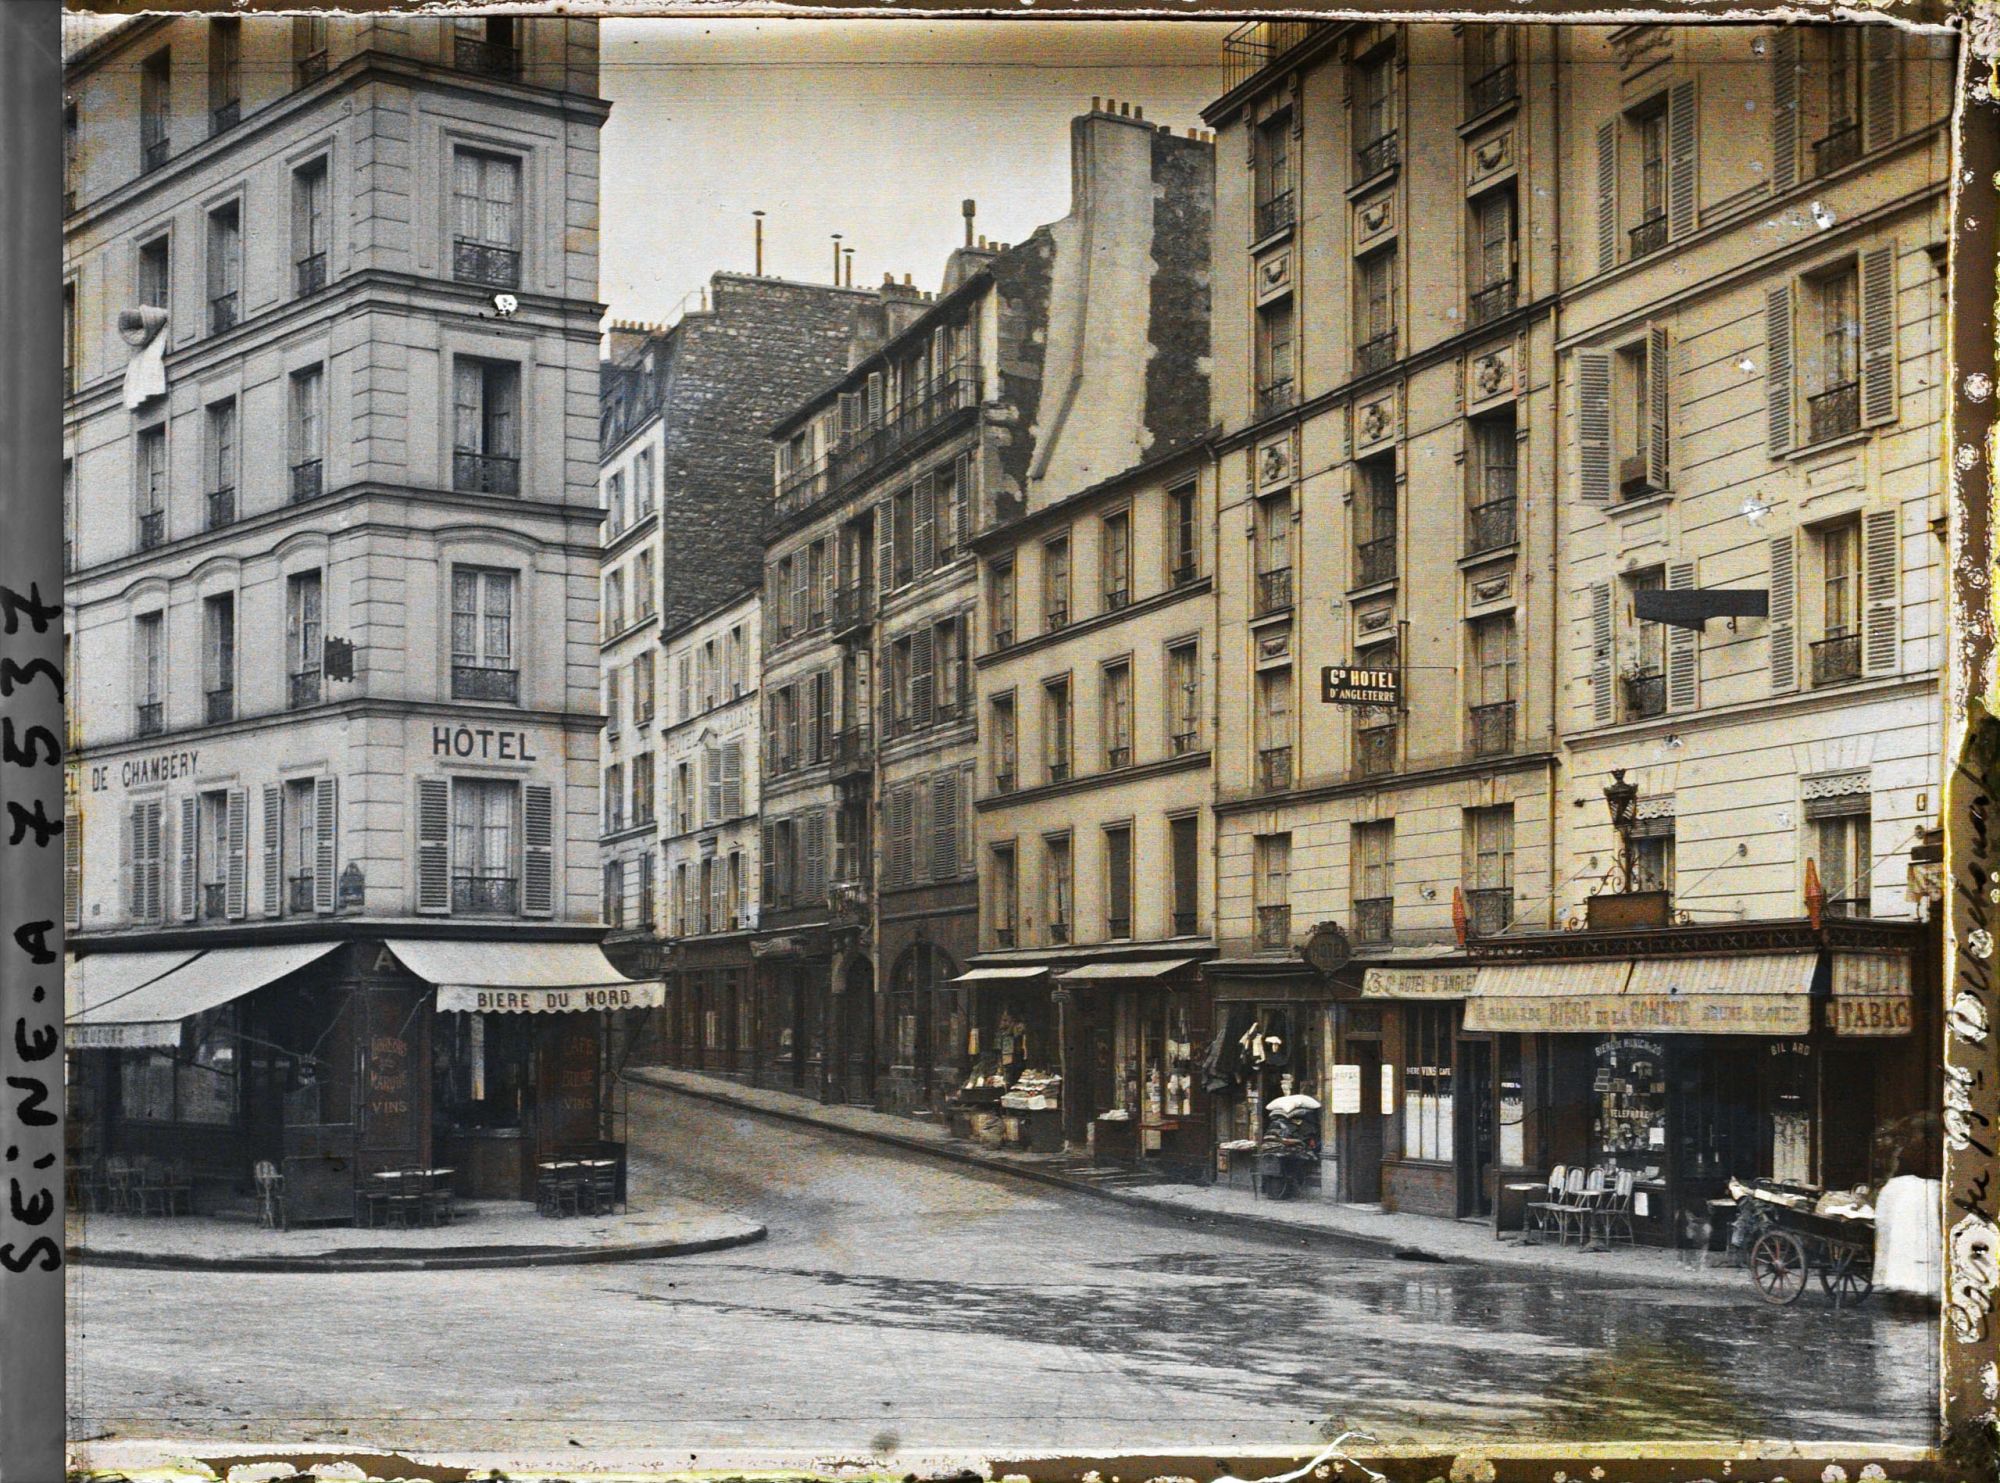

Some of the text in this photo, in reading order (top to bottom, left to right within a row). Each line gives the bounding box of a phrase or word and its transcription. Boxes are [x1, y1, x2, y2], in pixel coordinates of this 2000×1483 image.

[1350, 670, 1396, 688] HOTEL
[1329, 688, 1395, 702] D'ANGLETERRE
[433, 723, 537, 762] HÔTEL
[92, 766, 108, 792] DE
[121, 750, 200, 788] CHAMBÉRY
[1399, 975, 1425, 992] HOTEL
[477, 989, 631, 1009] BIERE DU NORD
[1841, 1002, 1909, 1028] TABAC
[1421, 1066, 1437, 1077] VINS
[372, 1101, 409, 1115] VINS
